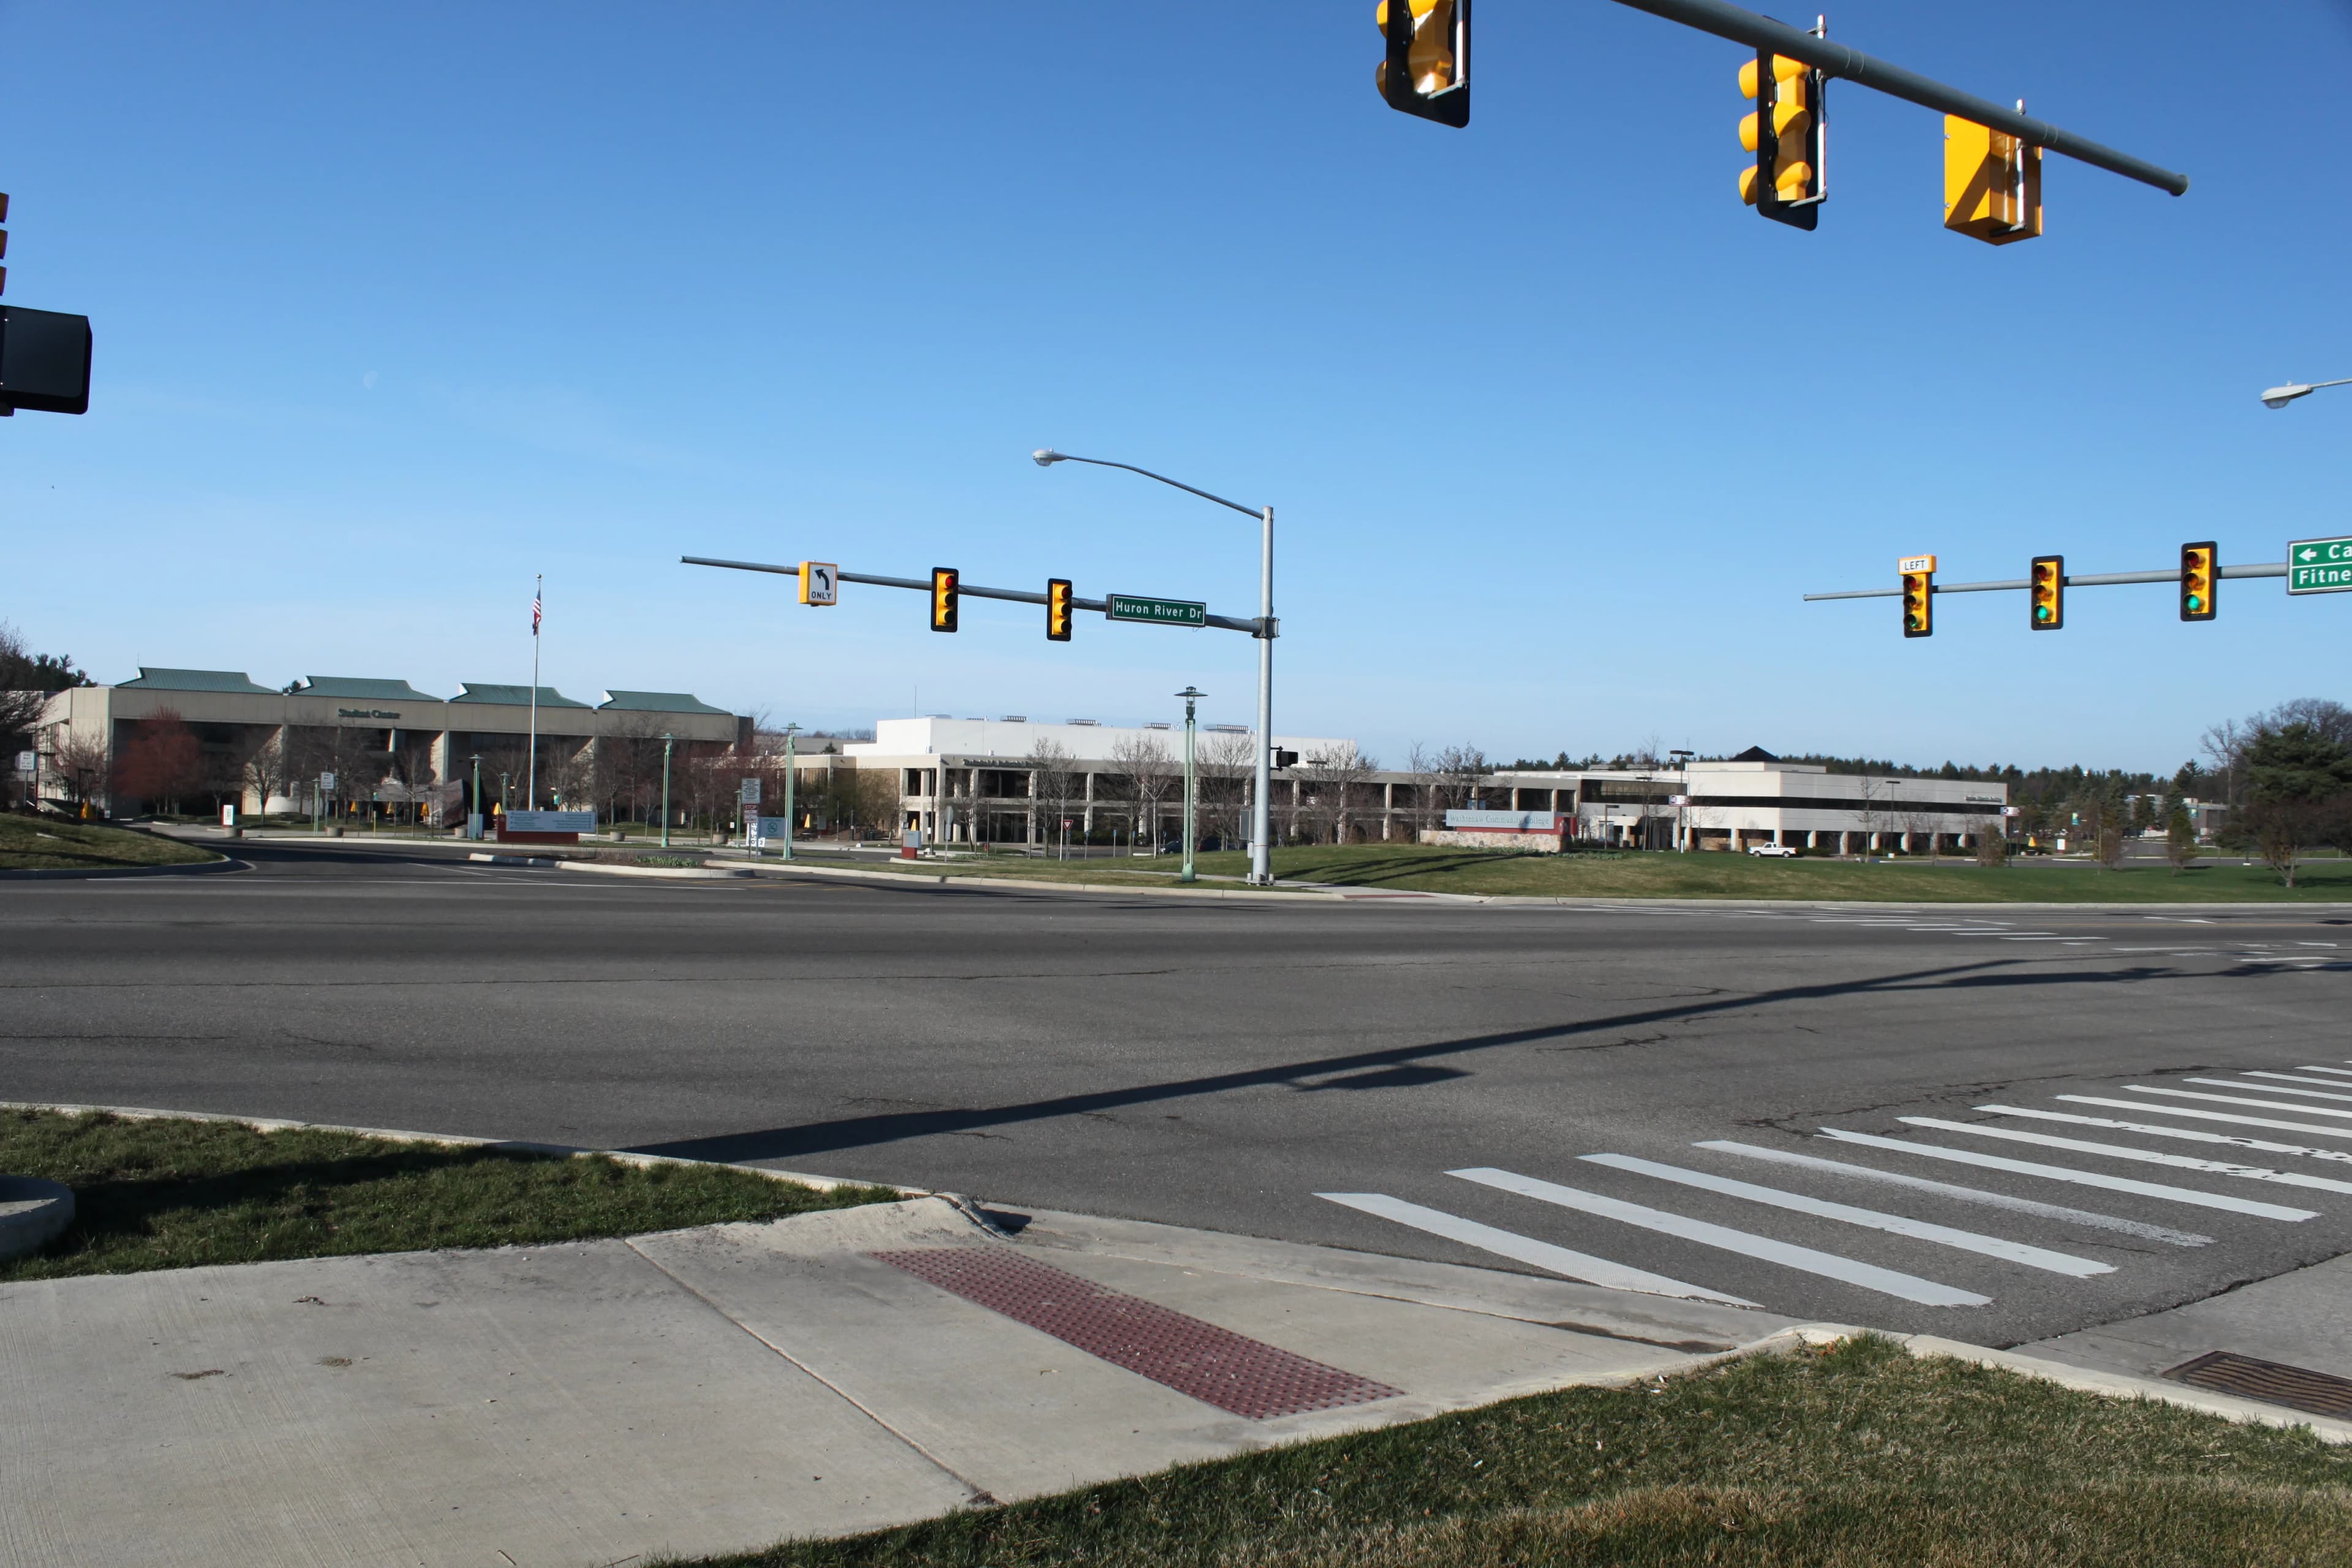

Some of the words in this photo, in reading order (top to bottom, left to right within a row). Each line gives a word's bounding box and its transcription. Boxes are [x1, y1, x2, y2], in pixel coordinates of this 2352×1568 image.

[2328, 544, 2352, 559] Ca
[1904, 560, 1925, 570] LEFT
[2299, 568, 2352, 584] Fitne
[811, 591, 831, 600] ONLY
[1115, 601, 1148, 614] Huron
[1155, 605, 1183, 617] River
[1189, 608, 1201, 619] Dr
[1486, 815, 1524, 826] Community
